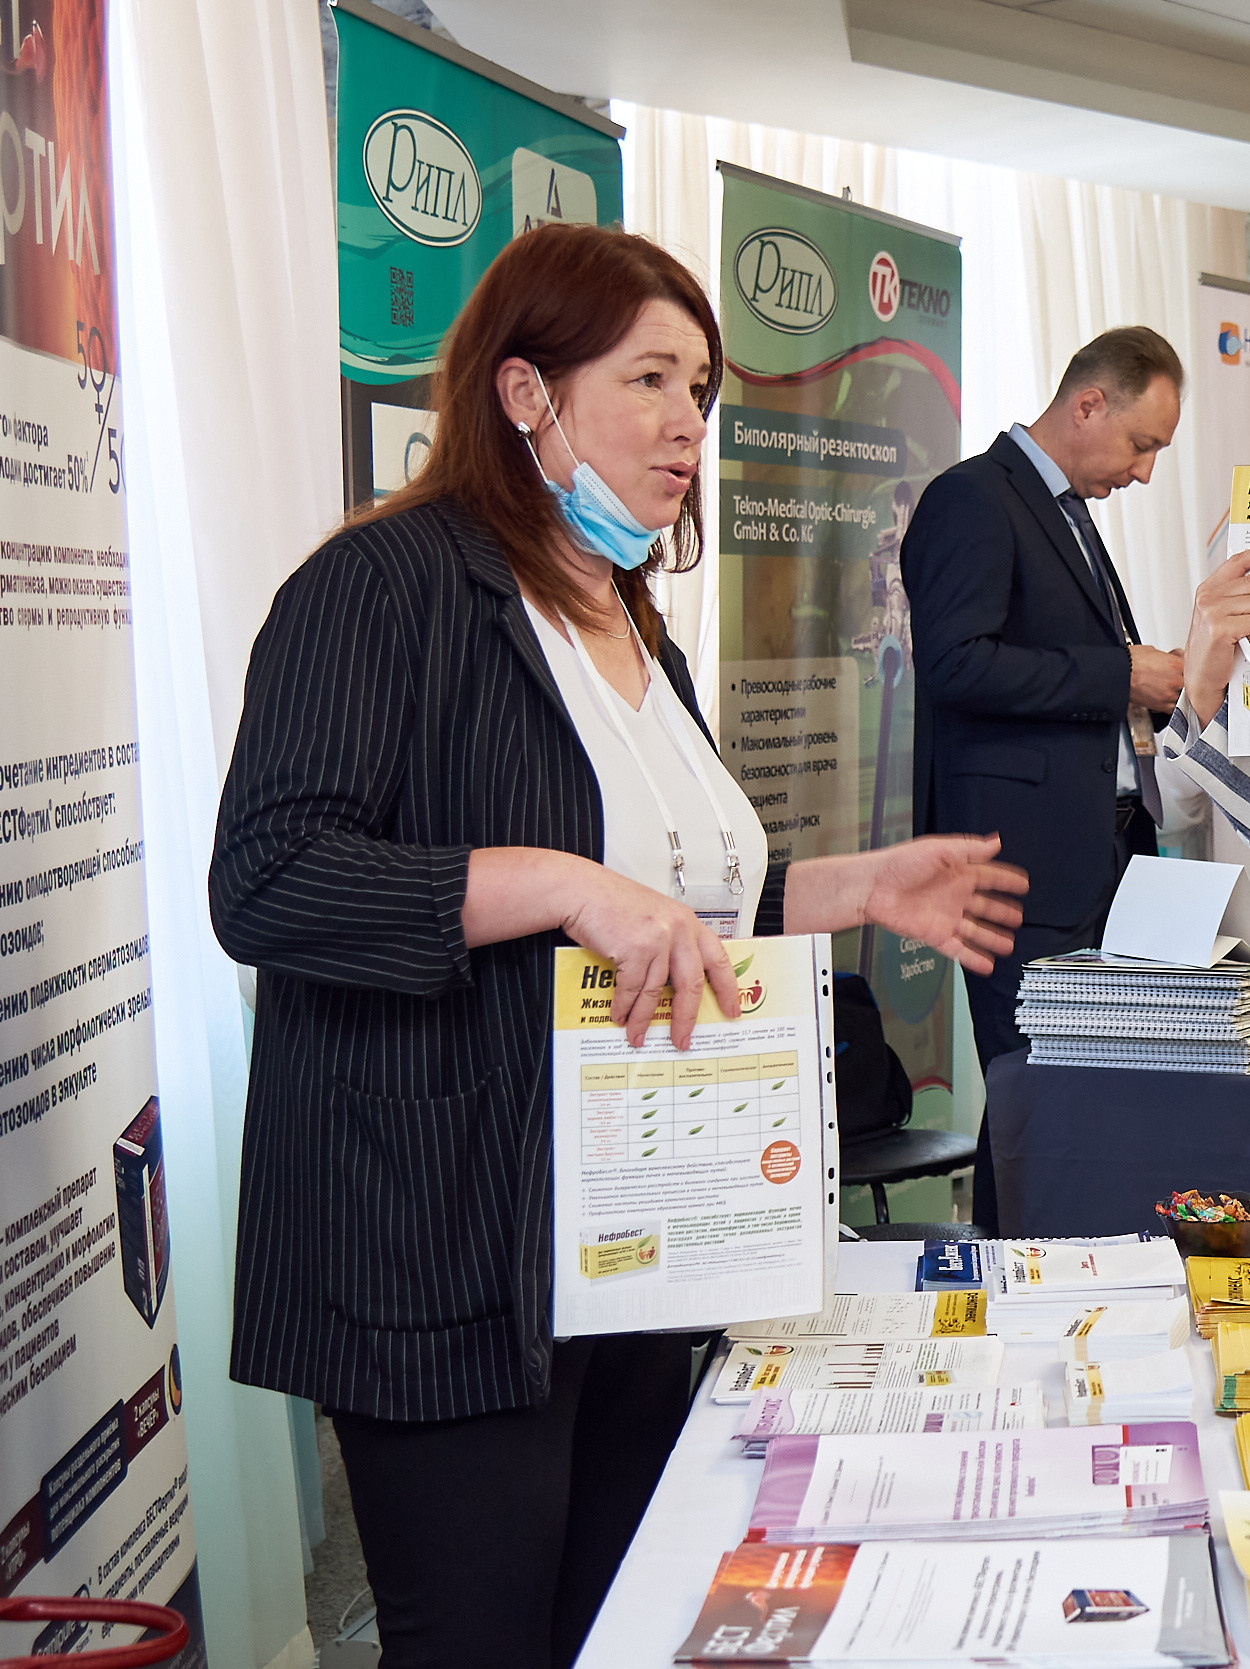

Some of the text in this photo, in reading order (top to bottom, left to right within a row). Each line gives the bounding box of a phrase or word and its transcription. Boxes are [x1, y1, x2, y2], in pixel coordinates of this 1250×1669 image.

[14, 411, 49, 452] фактора
[733, 420, 897, 464] Биполярный резектоскоп
[23, 461, 65, 490] достигает
[733, 495, 876, 530] Tekno-Medical Optic-Chirurgie
[733, 520, 814, 543] GmbH & Co. KG
[48, 608, 53, 626] и
[46, 745, 107, 785] ингредиентов
[108, 747, 115, 768] в
[812, 756, 838, 774] врача
[54, 791, 117, 830] способствует:
[26, 848, 102, 899] оплодотворяющей
[30, 962, 88, 1009] подвижности
[31, 1036, 56, 1071] числа
[57, 1002, 126, 1057] морфологически
[580, 1016, 586, 1024] и
[51, 1089, 57, 1108] в
[58, 1062, 98, 1103] эякуляте
[5, 1185, 63, 1247] комплексный
[63, 1166, 97, 1207] препарат
[5, 1233, 50, 1280] составом,
[597, 1227, 645, 1244] НефроБест
[5, 1211, 116, 1311] концентрацию и морфологию
[21, 1280, 74, 1332] обеспечивая
[74, 1241, 116, 1288] повышение
[15, 1318, 60, 1372] пациентов
[30, 1333, 77, 1389] бесплодием
[97, 1565, 103, 1586] В
